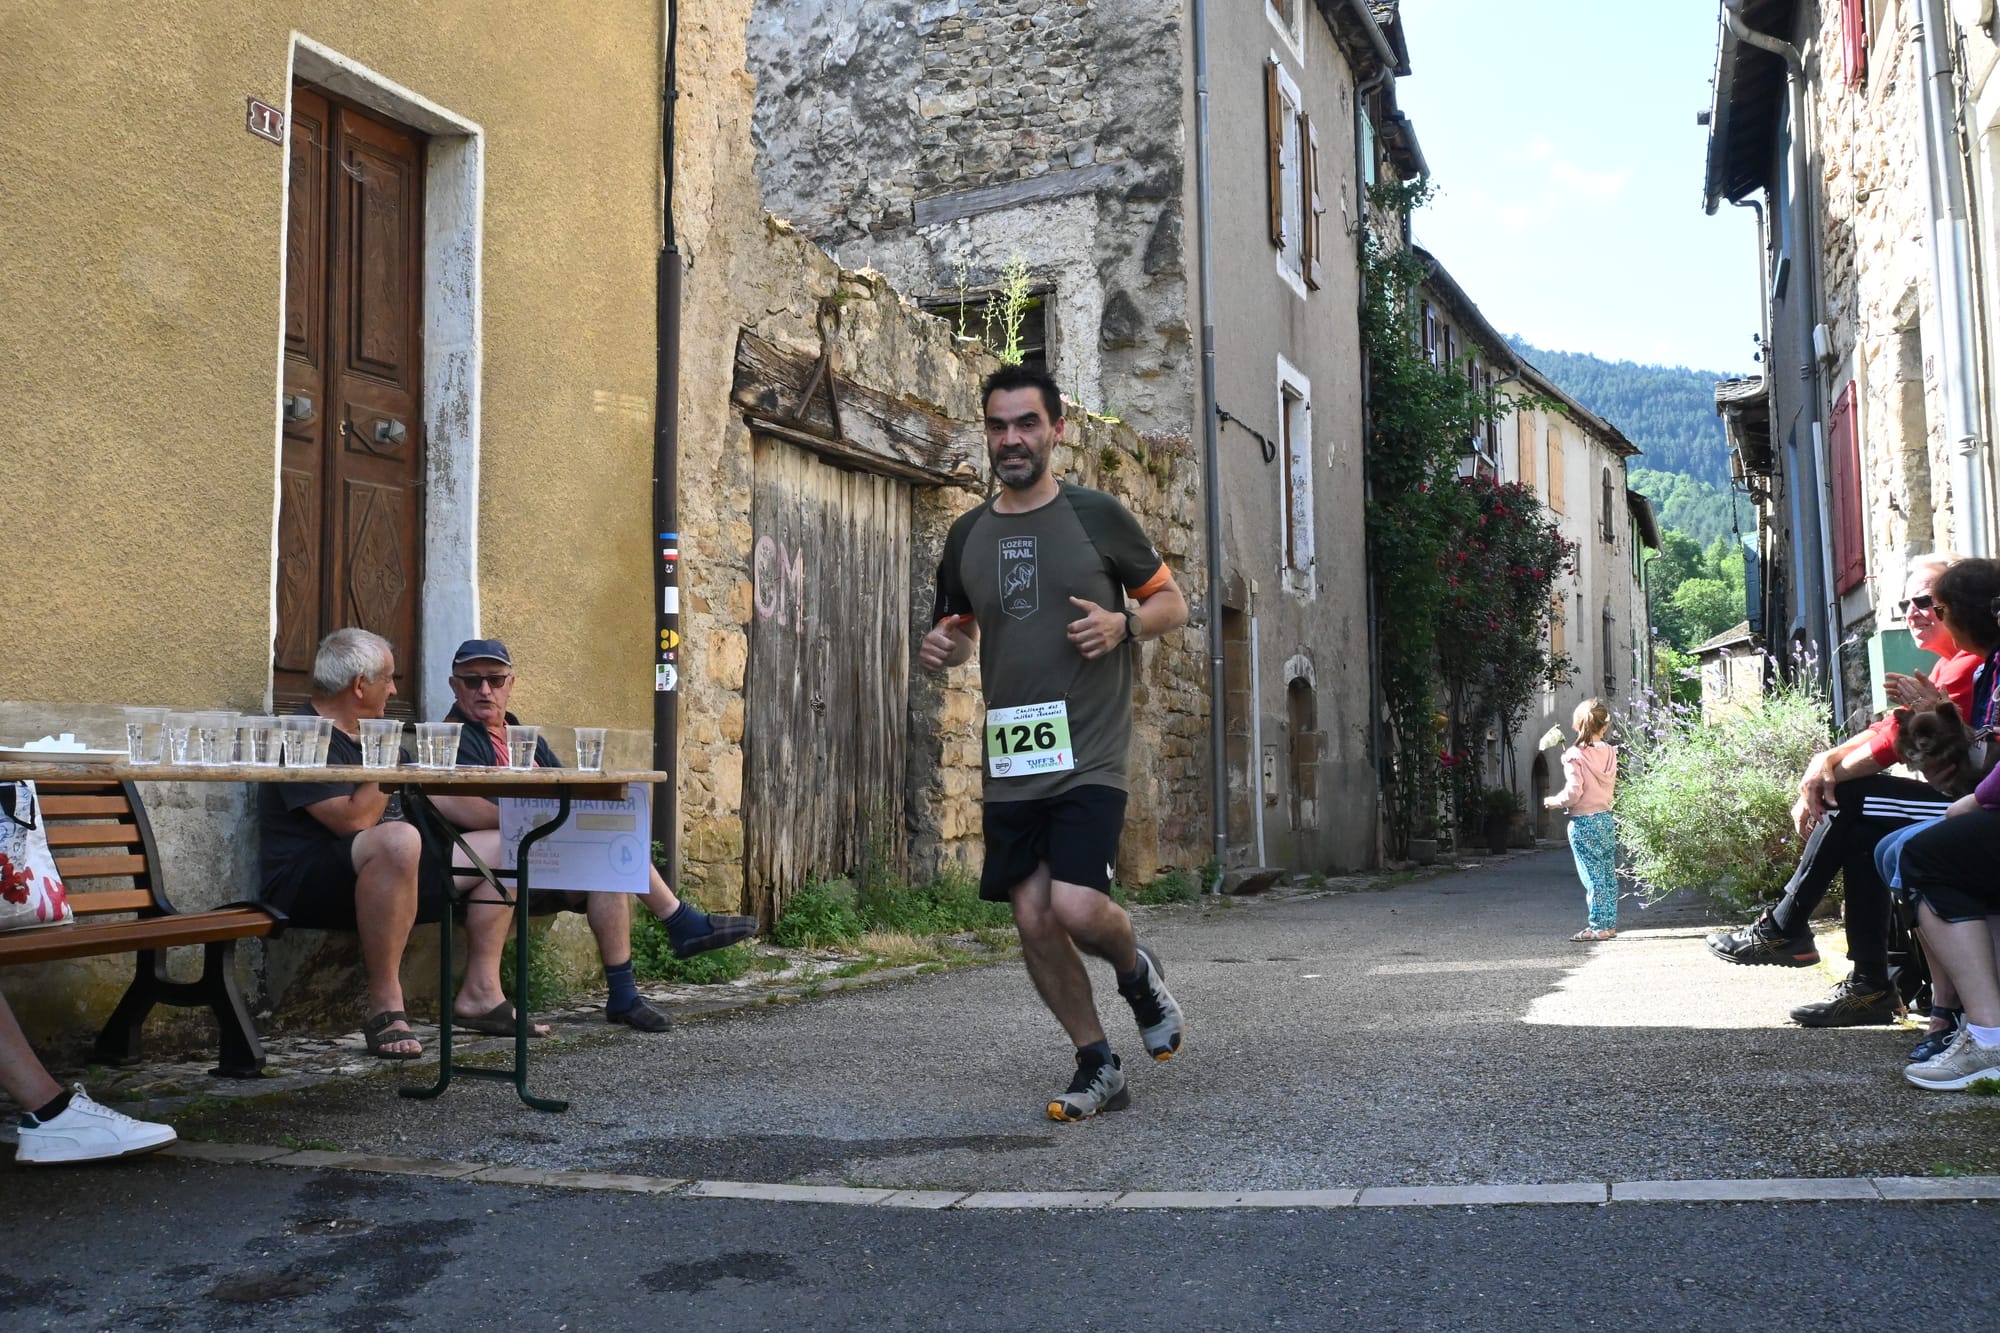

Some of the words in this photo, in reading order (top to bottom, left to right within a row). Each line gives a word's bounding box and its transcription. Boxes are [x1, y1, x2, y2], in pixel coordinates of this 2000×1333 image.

[263, 110, 270, 134] 1
[1002, 540, 1033, 549] LOZÈRE
[1003, 549, 1033, 560] TRAIL
[995, 722, 1056, 754] 126
